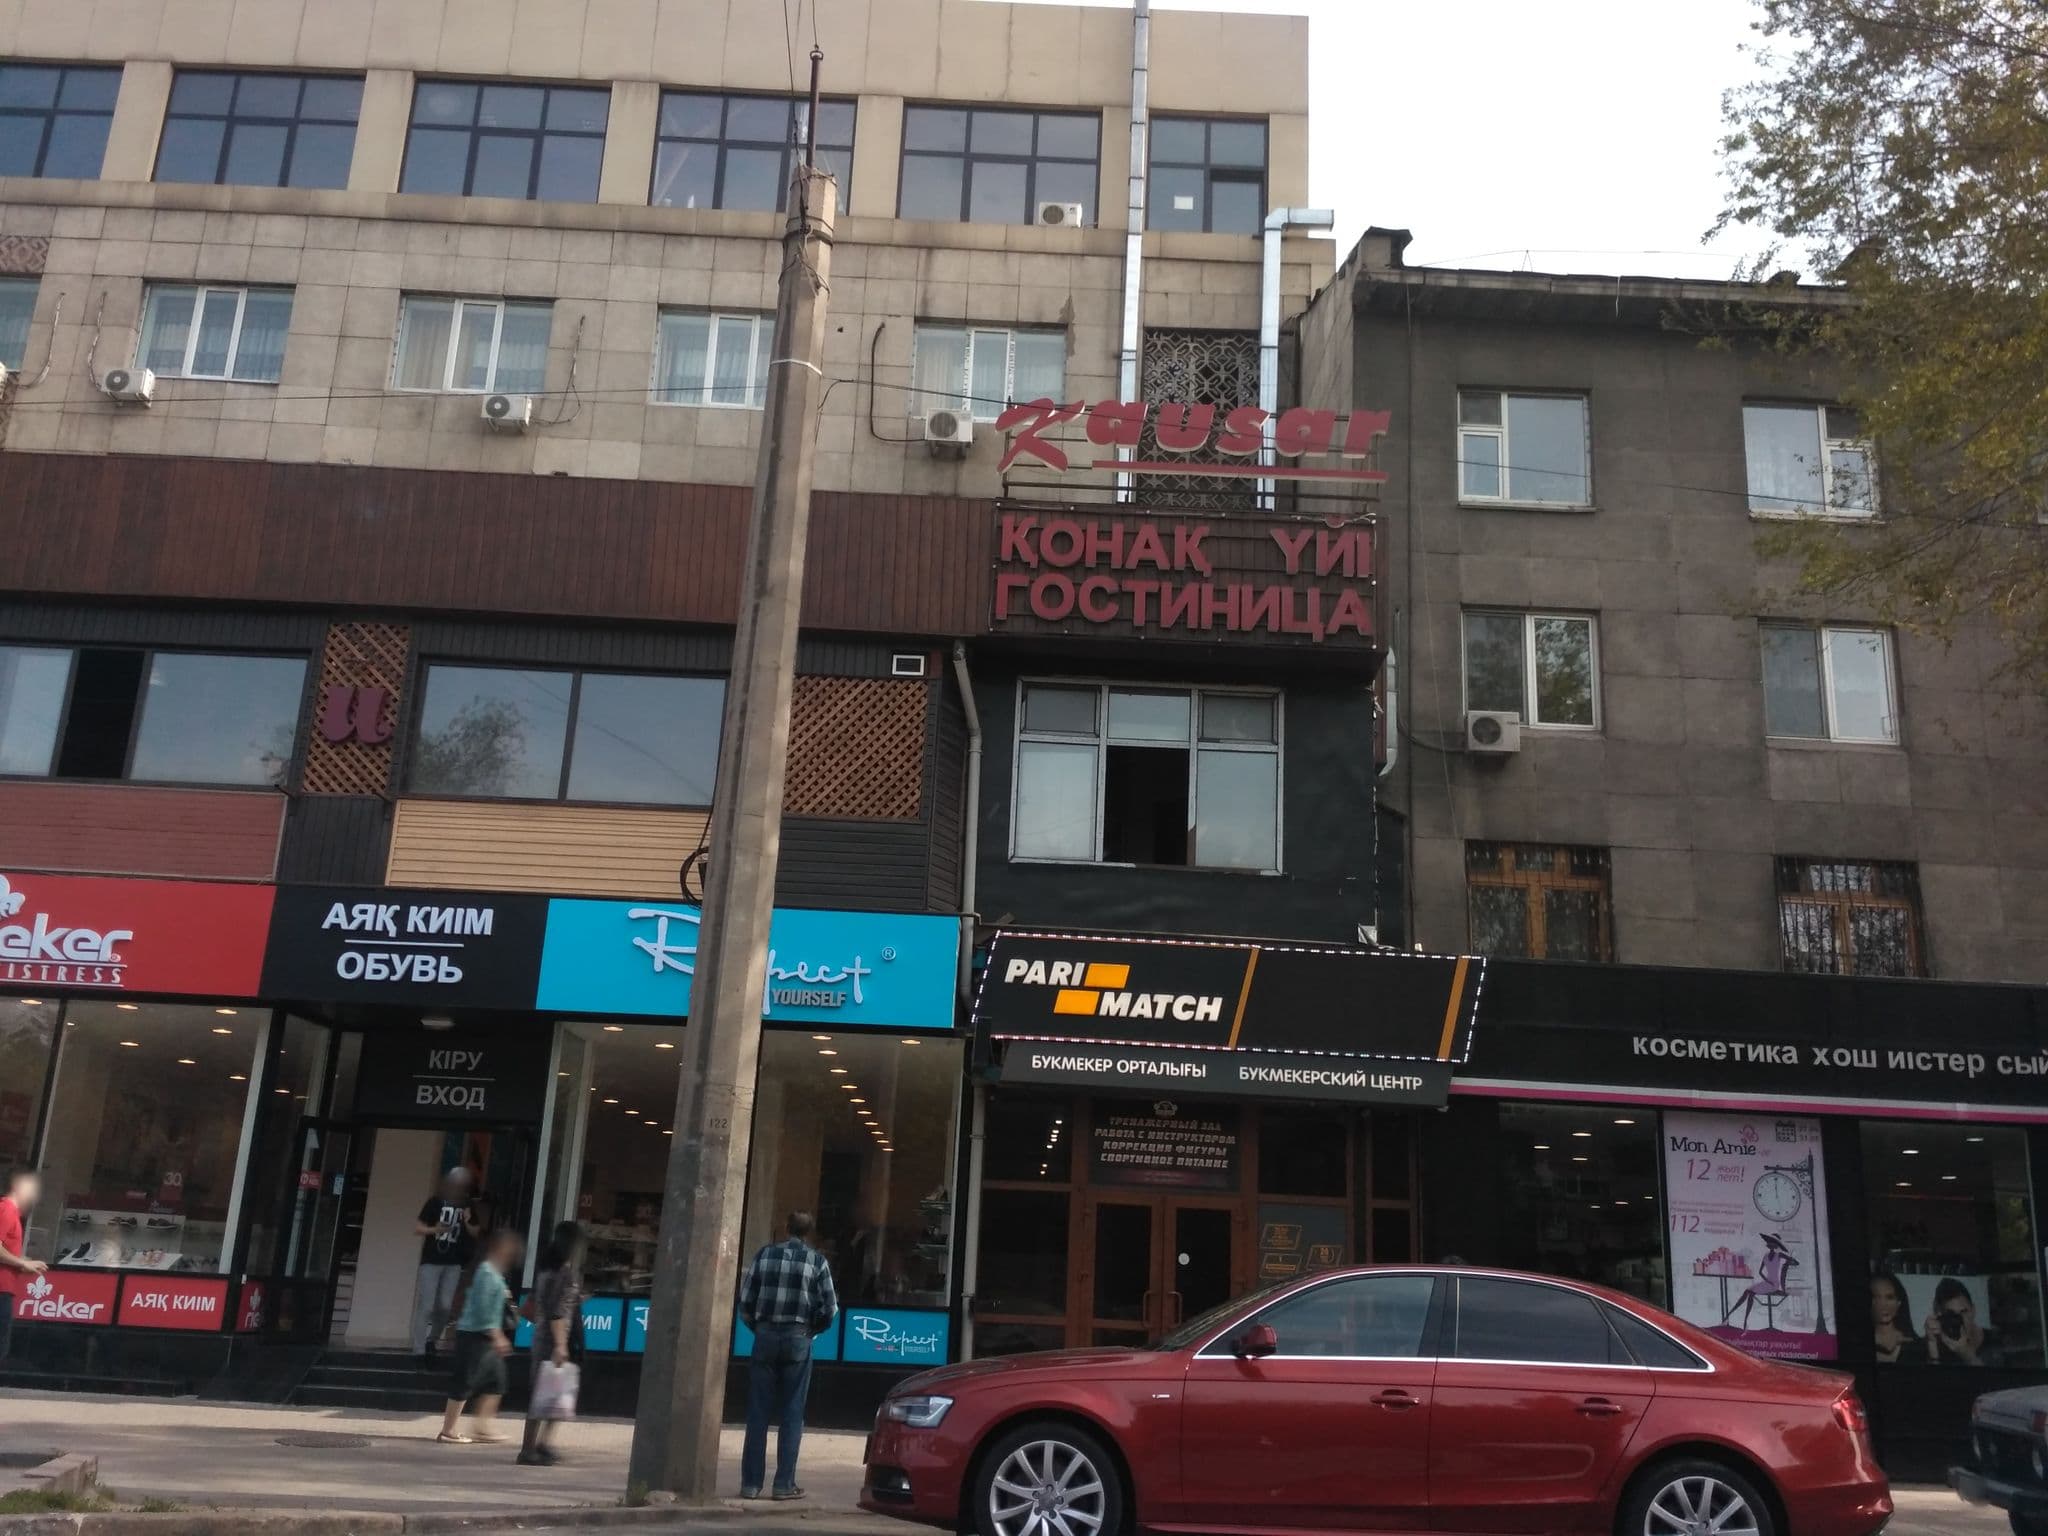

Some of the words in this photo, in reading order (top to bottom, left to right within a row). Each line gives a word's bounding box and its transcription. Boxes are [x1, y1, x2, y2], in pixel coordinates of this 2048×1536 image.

[995, 397, 1392, 473] Kausar
[1001, 515, 1213, 576] ҚОНАҚ
[995, 573, 1374, 643] ГОСТИНИЦА
[322, 903, 400, 937] АЯҚ
[406, 906, 494, 936] КИІМ
[337, 951, 463, 983] ОБУВЬ
[1004, 958, 1085, 987] PARI
[772, 988, 846, 1008] YOURSELF
[1099, 991, 1222, 1022] MATCH
[429, 1050, 483, 1071] КІРУ
[1633, 1035, 1798, 1065] косметика
[1812, 1047, 1877, 1068] хош
[1031, 1055, 1113, 1073] БУКМЕКЕР
[1117, 1059, 1207, 1078] ОРТАЛЫҒЫ
[1239, 1066, 1365, 1088] БУКМЕКЕРСКИЙ
[1370, 1072, 1423, 1091] ЦЕНТР
[416, 1085, 485, 1111] ВХОД
[1094, 1128, 1135, 1139] РАБОТА
[1670, 1136, 1708, 1153] Mon
[1712, 1138, 1757, 1156] Amie
[1686, 1158, 1712, 1181] 12
[1670, 1214, 1701, 1233] 112
[19, 1294, 104, 1320] rieker
[131, 1293, 168, 1312] АЯҚ
[172, 1295, 216, 1312] КИІМ
[852, 1315, 938, 1357] Respect
